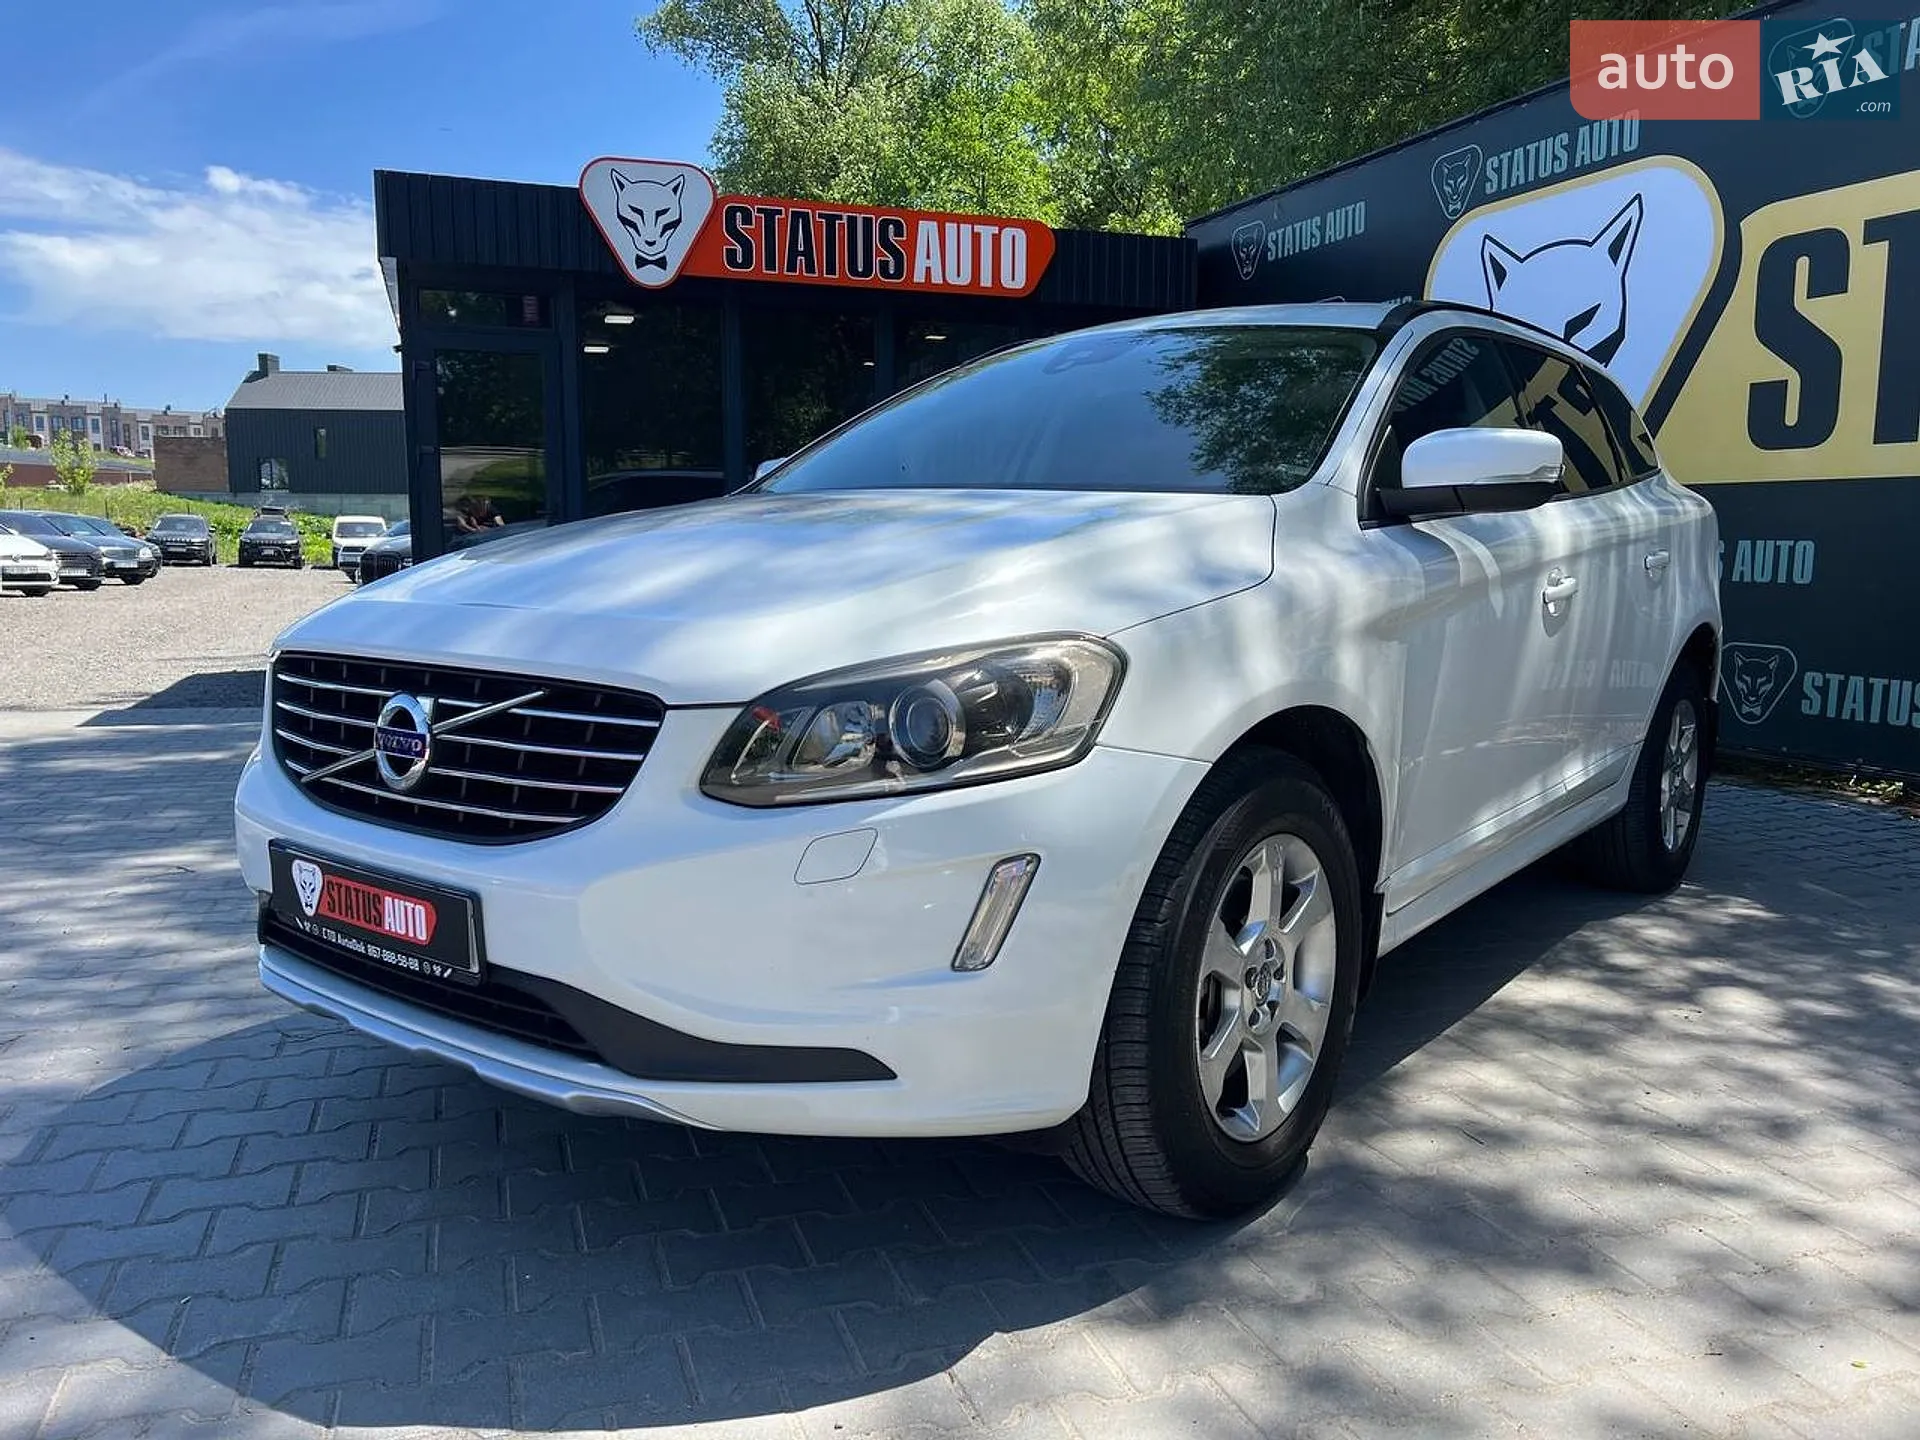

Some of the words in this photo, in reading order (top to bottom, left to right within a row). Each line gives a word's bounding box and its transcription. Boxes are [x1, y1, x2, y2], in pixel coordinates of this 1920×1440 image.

[1485, 132, 1569, 195] STATUS
[1574, 109, 1640, 168] AUTO
[723, 203, 906, 281] STATUS
[913, 220, 1027, 289] AUTO
[1267, 216, 1321, 261] STATUS
[1325, 201, 1366, 244] AUTO
[1732, 540, 1815, 584] AUTO
[377, 732, 422, 752] VOLVO
[326, 880, 382, 926] STATUS
[384, 896, 427, 941] AUTO
